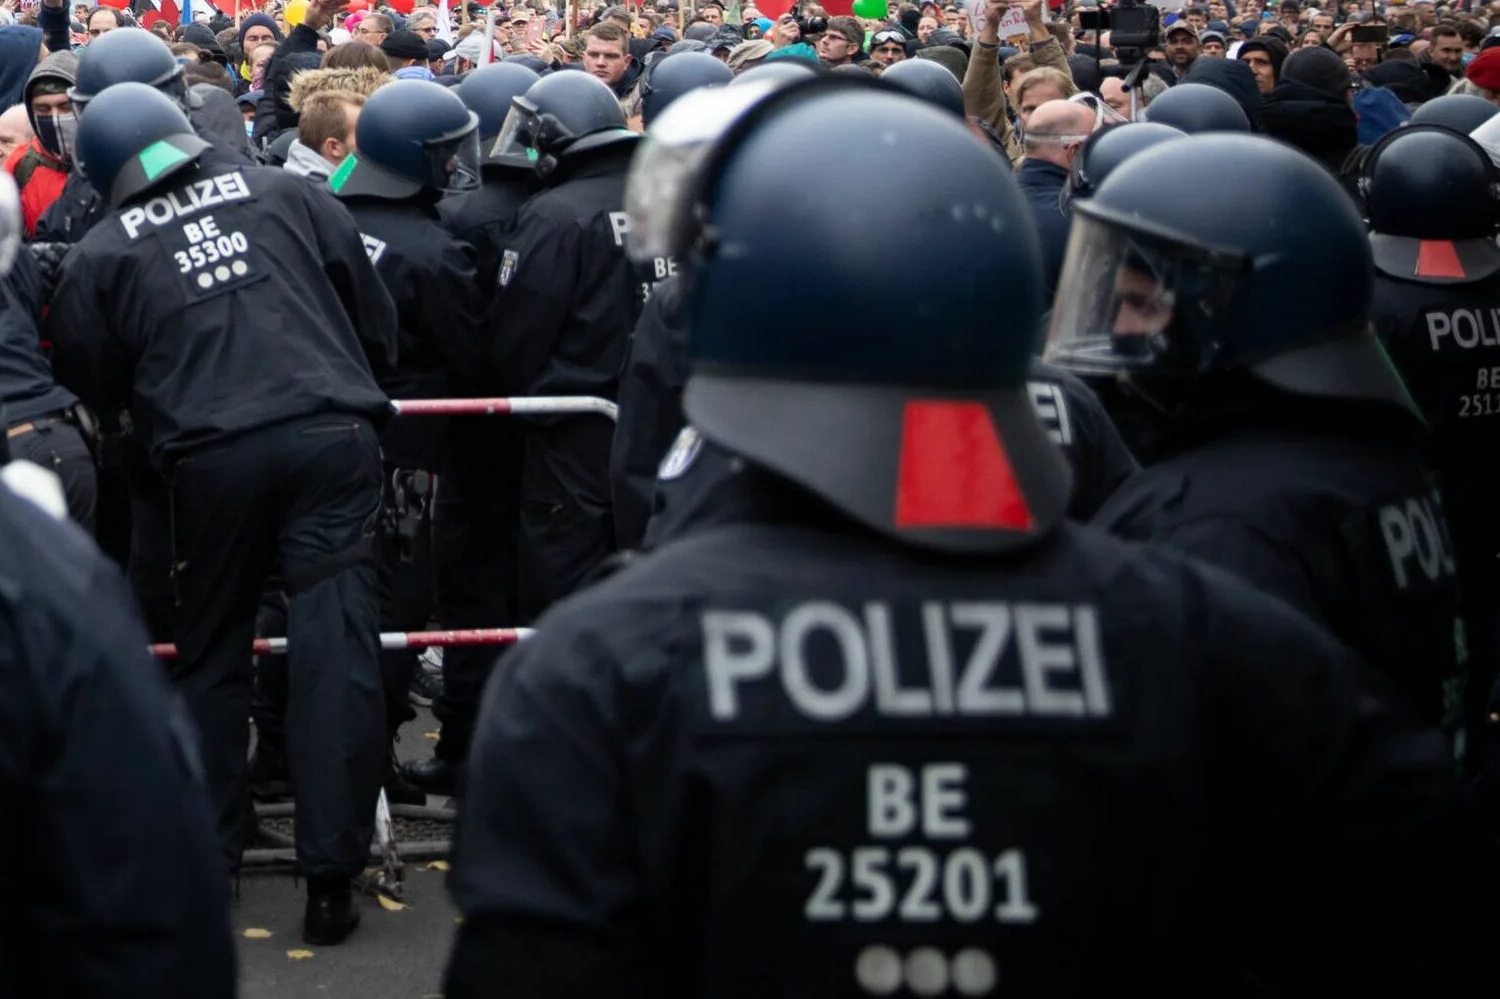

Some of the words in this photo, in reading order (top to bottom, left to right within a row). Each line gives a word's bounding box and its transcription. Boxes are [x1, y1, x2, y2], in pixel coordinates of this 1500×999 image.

[119, 171, 250, 239] POLIZEI
[183, 215, 220, 245] BE
[174, 231, 248, 273] 35300
[653, 257, 678, 279] BE
[1425, 307, 1500, 350] POLI
[1476, 366, 1500, 390] BE
[701, 599, 1114, 722] POLIZEI
[866, 762, 973, 839] BE
[804, 846, 1040, 923] 25201
